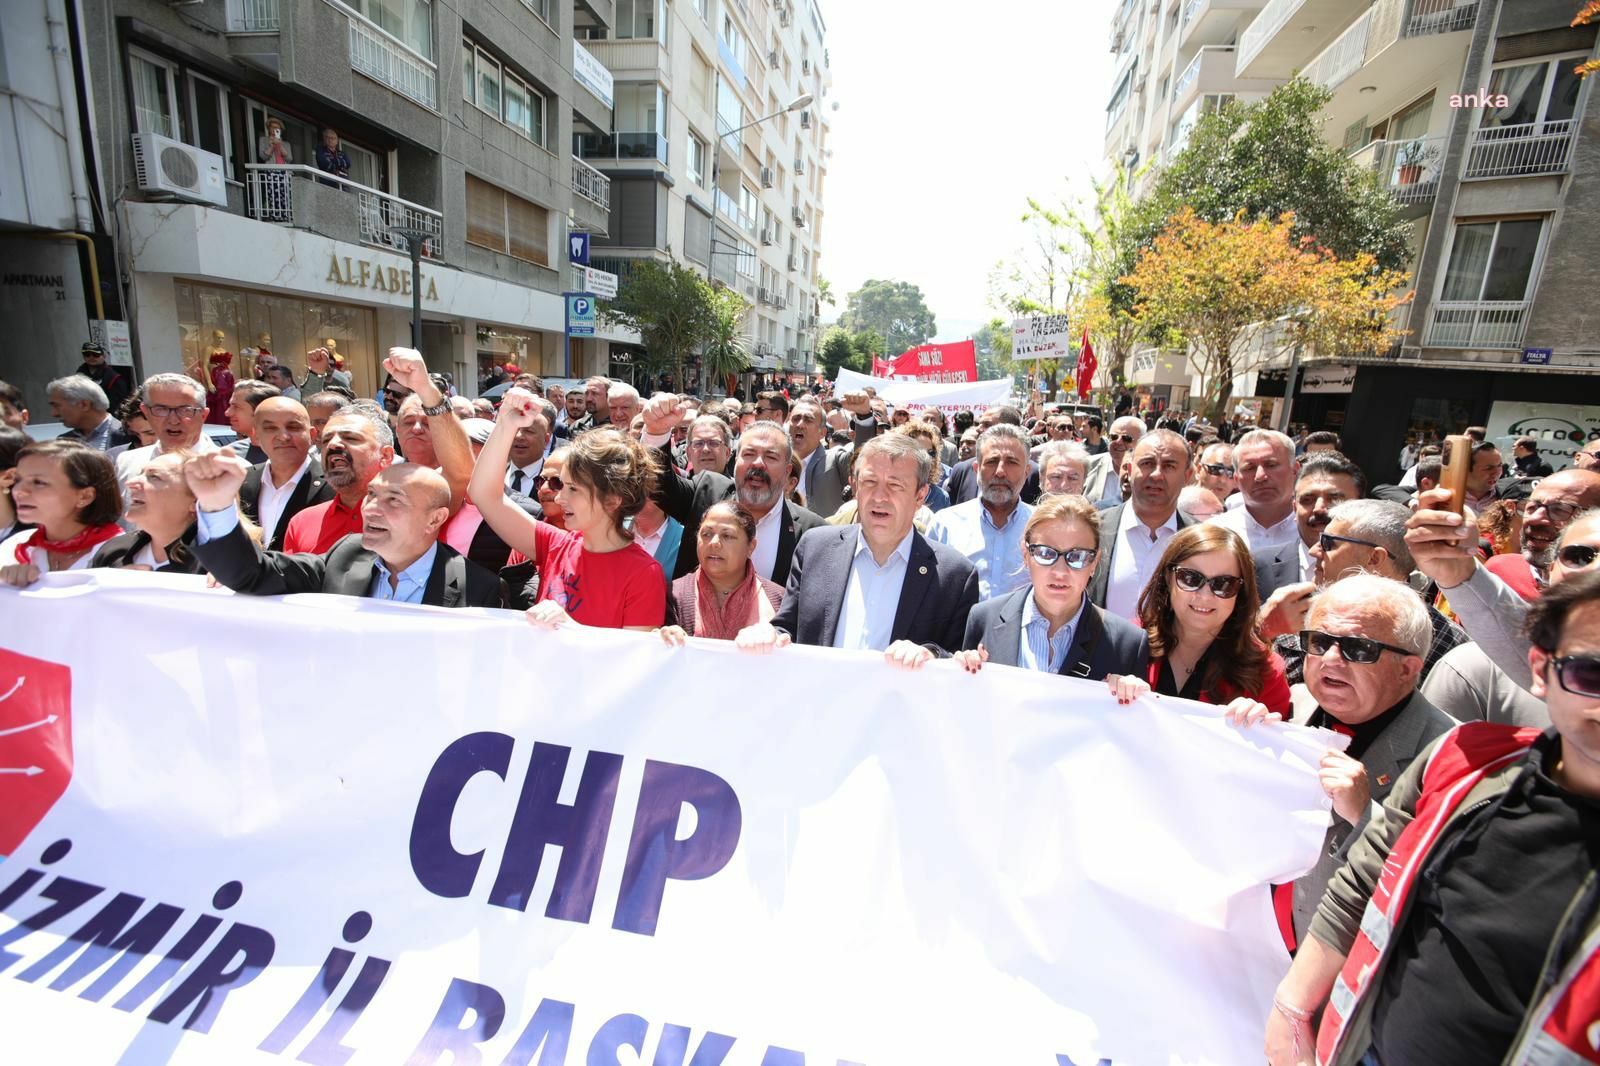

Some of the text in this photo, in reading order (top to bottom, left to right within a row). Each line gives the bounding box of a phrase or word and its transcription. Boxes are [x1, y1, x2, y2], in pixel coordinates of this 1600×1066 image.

[3, 273, 64, 288] APARTMANI
[55, 290, 66, 300] 21
[577, 299, 587, 313] P
[409, 731, 742, 937] CHP
[0, 838, 276, 1035] İZMİR
[256, 910, 392, 1066] İL
